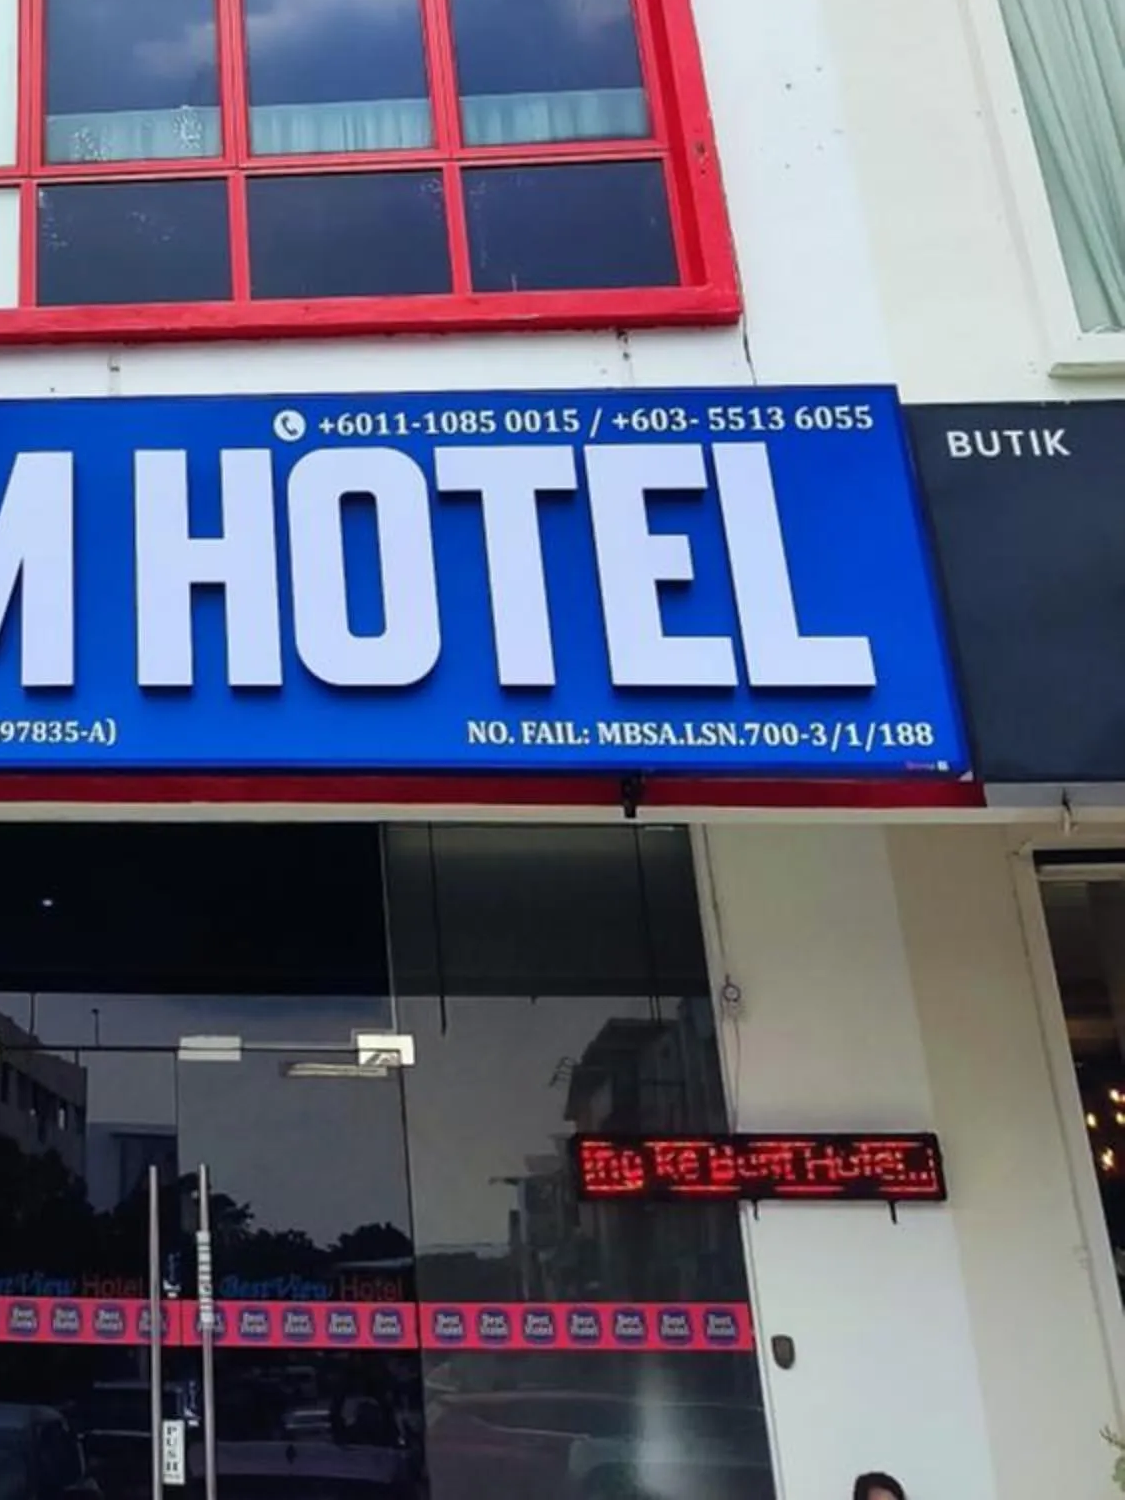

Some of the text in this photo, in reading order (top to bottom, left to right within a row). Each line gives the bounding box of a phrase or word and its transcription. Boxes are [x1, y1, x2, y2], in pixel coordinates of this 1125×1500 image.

[318, 409, 496, 436] +6011-1085
[504, 408, 580, 433] 0015
[611, 407, 699, 432] +603-
[707, 405, 786, 431] 5513
[795, 404, 874, 430] 6055
[946, 428, 1071, 458] BUTIK
[133, 442, 877, 687] HOTEL
[467, 721, 516, 745] NO.
[522, 722, 590, 745] FAIL:
